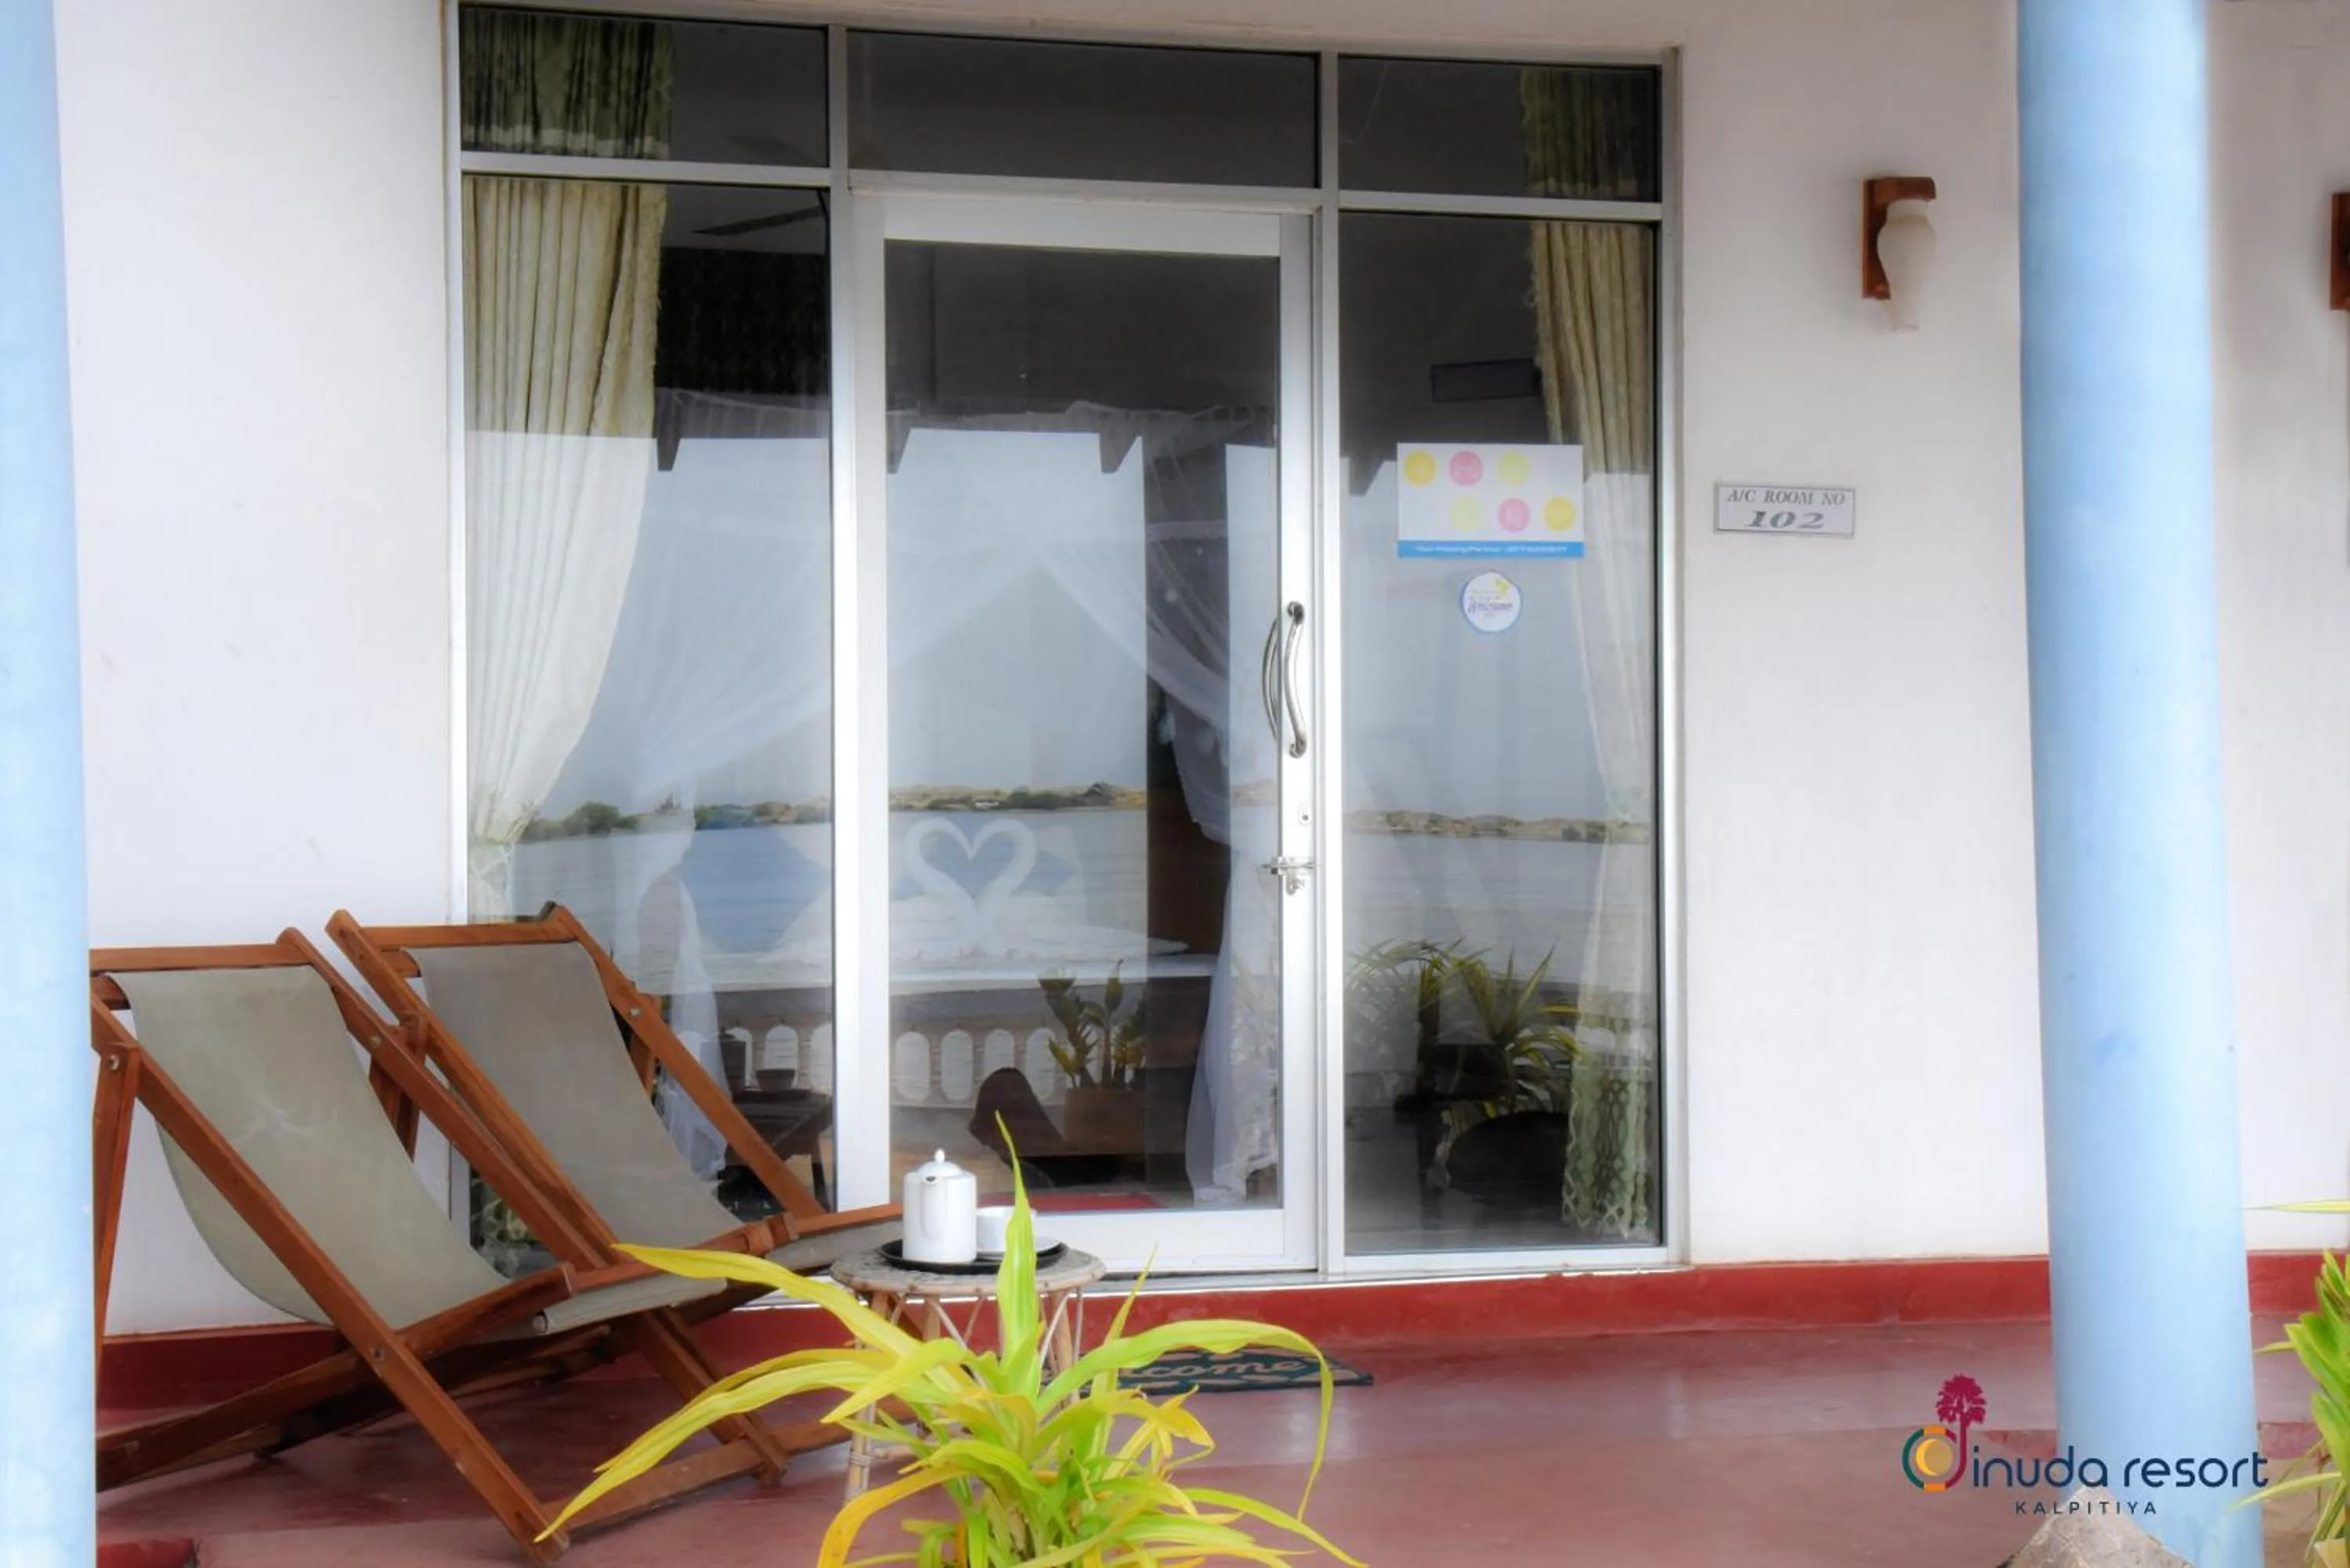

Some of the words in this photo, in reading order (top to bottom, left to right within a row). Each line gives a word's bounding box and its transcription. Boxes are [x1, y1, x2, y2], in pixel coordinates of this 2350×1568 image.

[1726, 489, 1756, 503] A/C
[1763, 490, 1814, 505] ROOM
[1821, 492, 1846, 506] NO
[1744, 510, 1825, 529] 102
